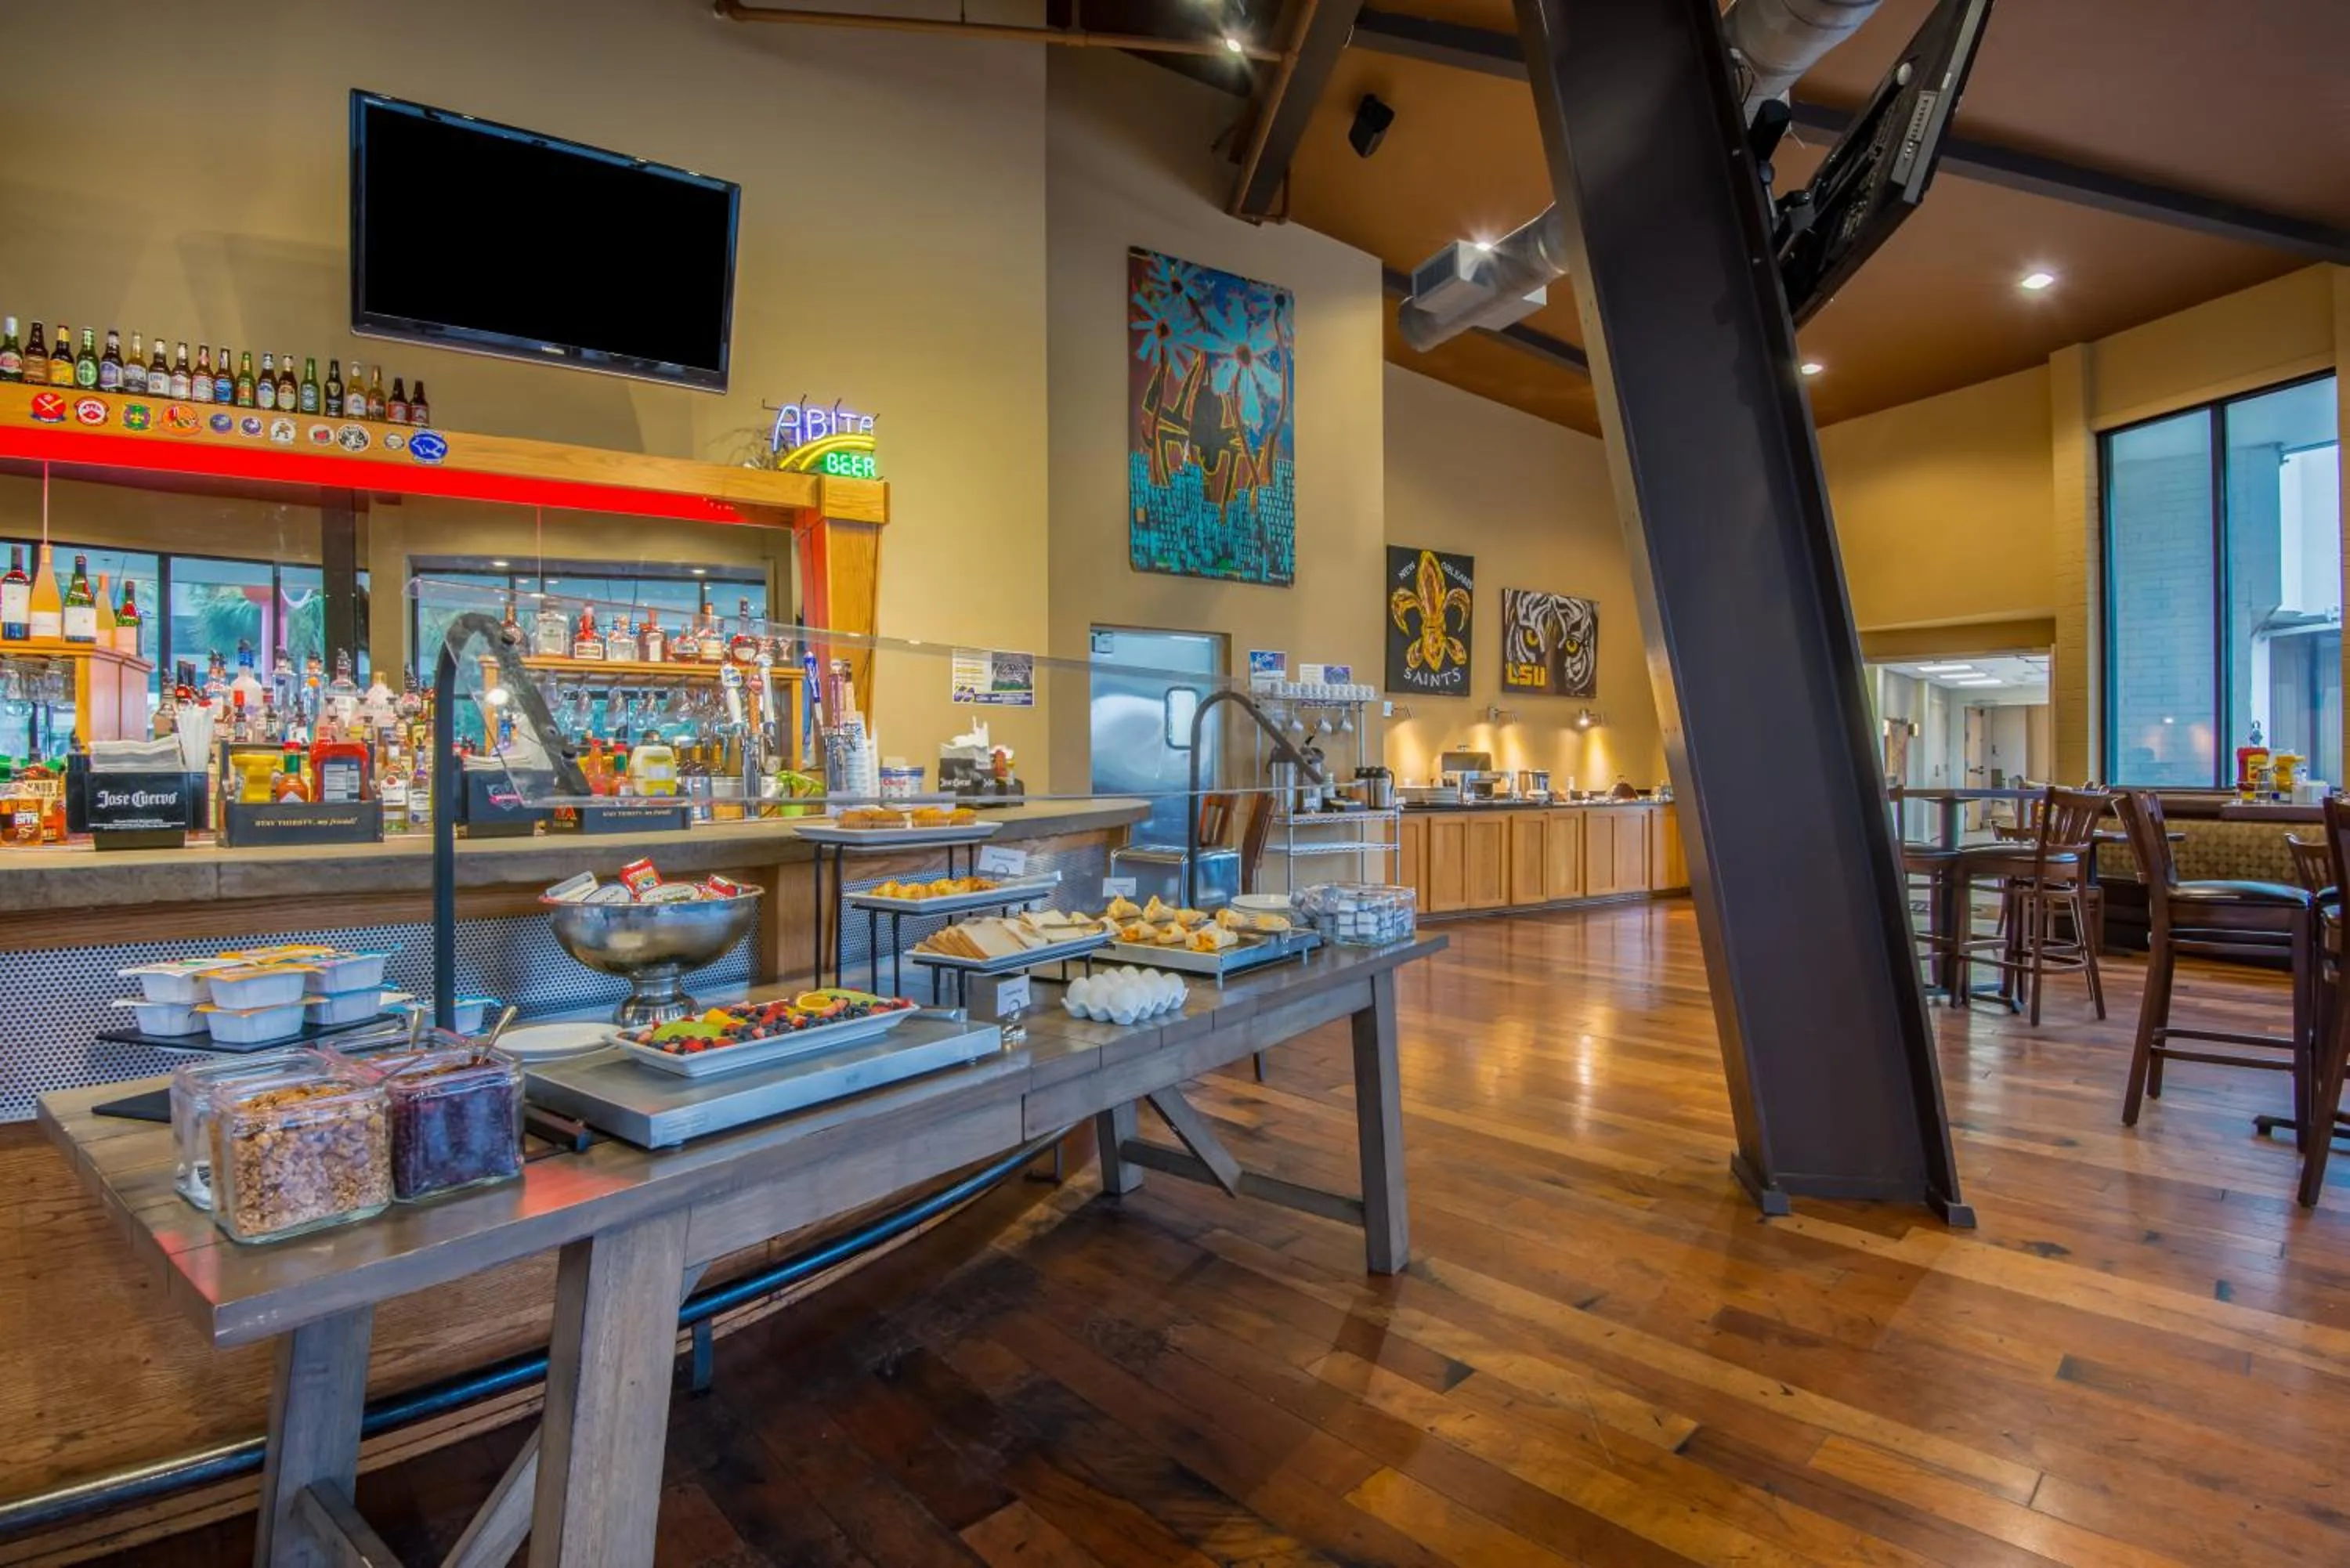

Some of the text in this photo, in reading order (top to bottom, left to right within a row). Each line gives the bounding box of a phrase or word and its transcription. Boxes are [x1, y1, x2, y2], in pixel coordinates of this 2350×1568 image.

[772, 404, 875, 452] ABITA
[826, 451, 876, 477] BEER
[1403, 667, 1462, 688] SAINTS
[1506, 662, 1546, 687] LSU
[96, 789, 179, 809] Jose Cuervo
